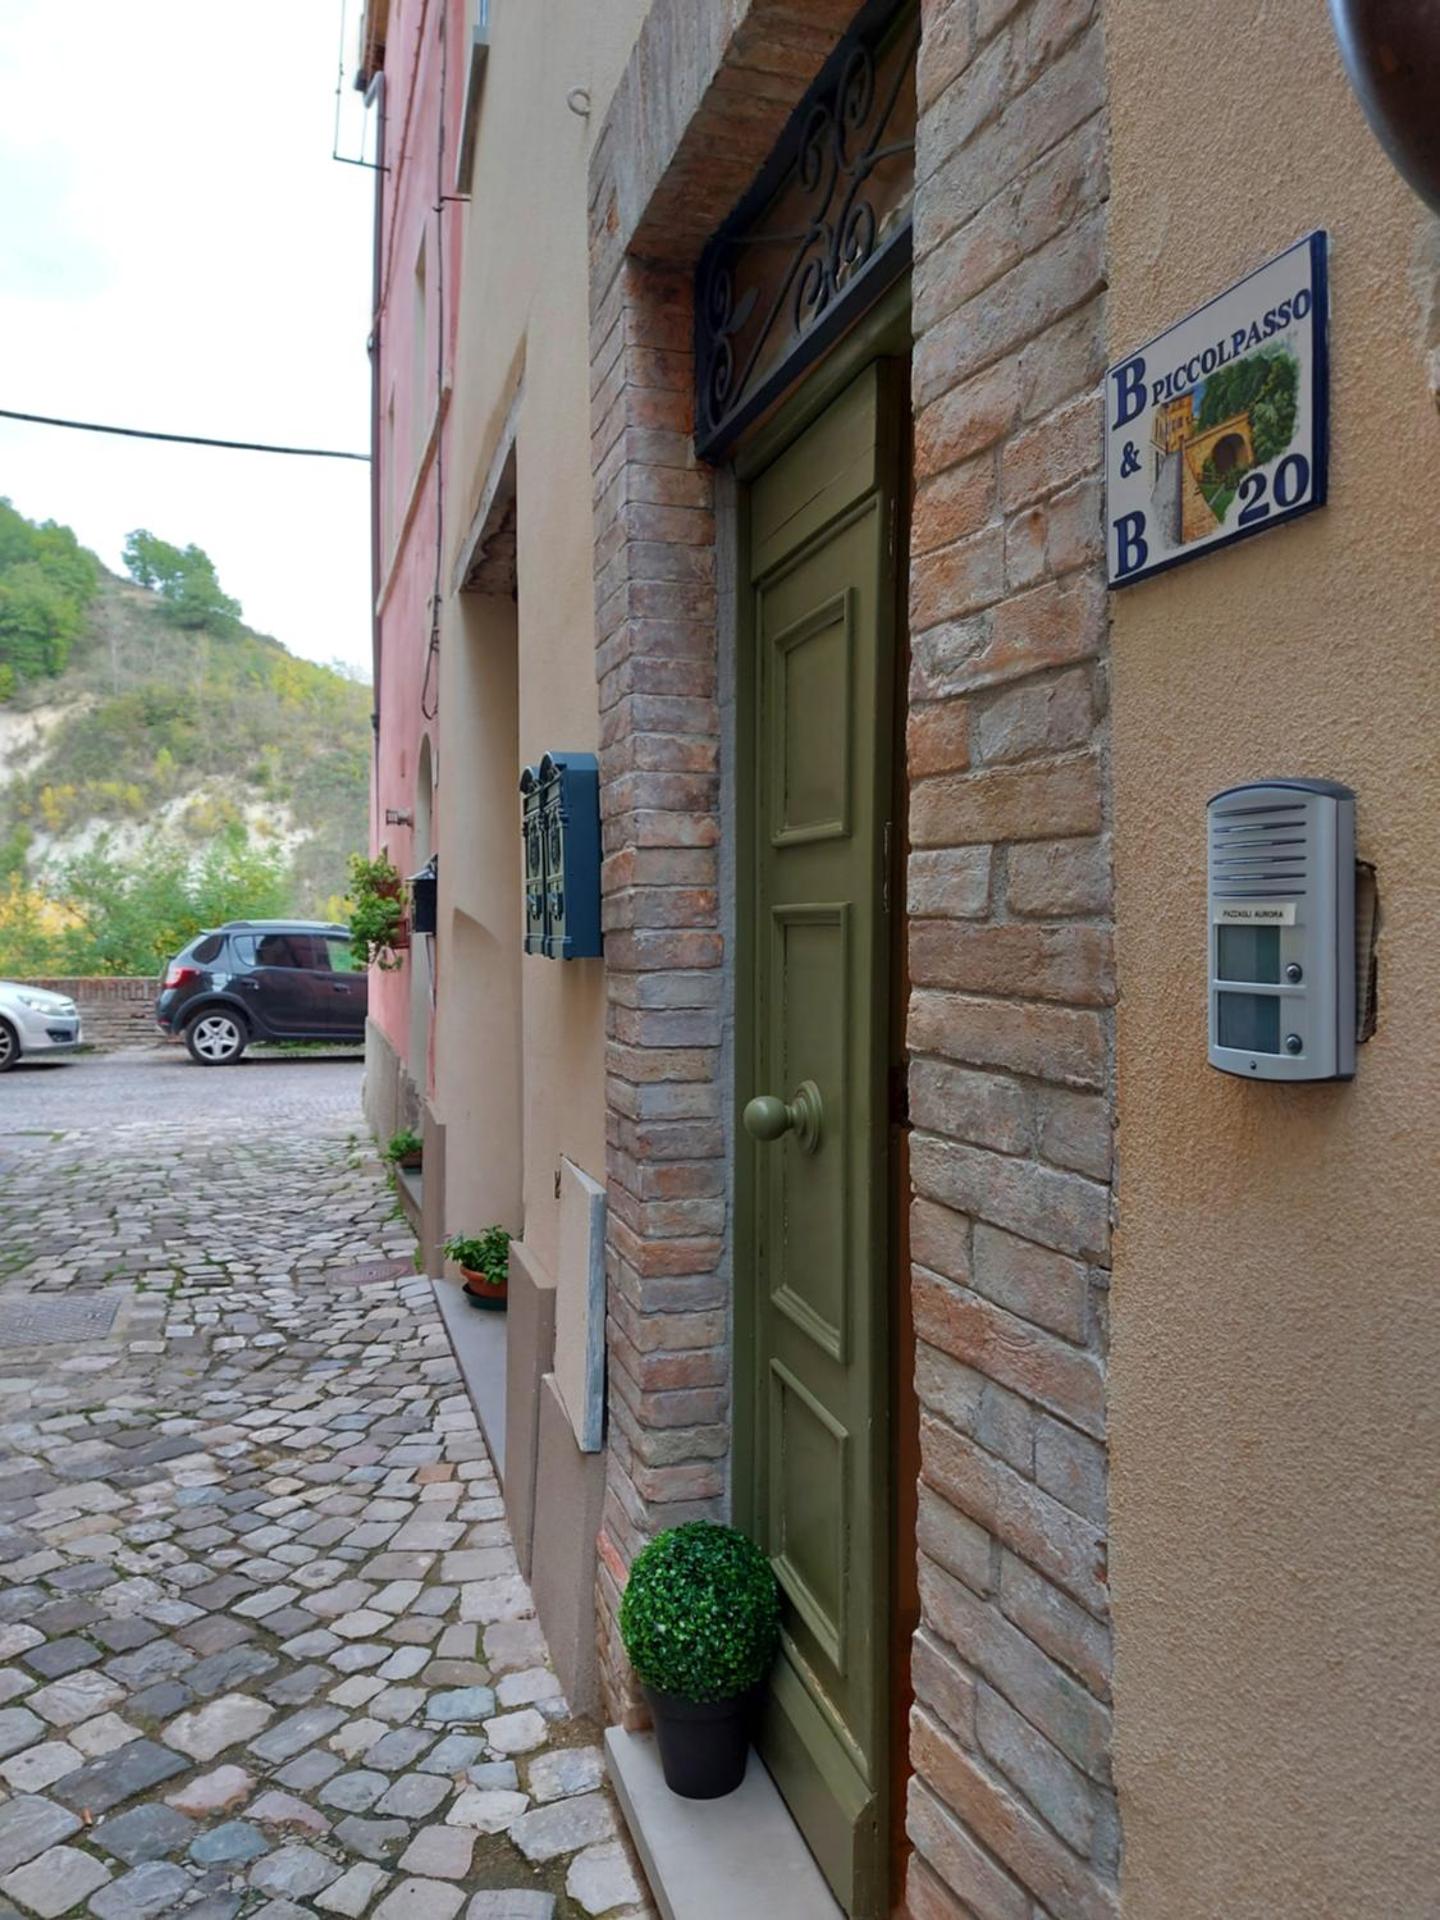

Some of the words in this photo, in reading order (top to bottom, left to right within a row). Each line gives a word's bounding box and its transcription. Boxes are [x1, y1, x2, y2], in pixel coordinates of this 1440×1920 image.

[1151, 288, 1312, 407] PICCOLPASSO
[1112, 357, 1147, 431] B
[1120, 440, 1142, 479] &
[1238, 453, 1310, 526] 20
[1113, 510, 1148, 578] B
[1254, 910, 1283, 918] AURORA
